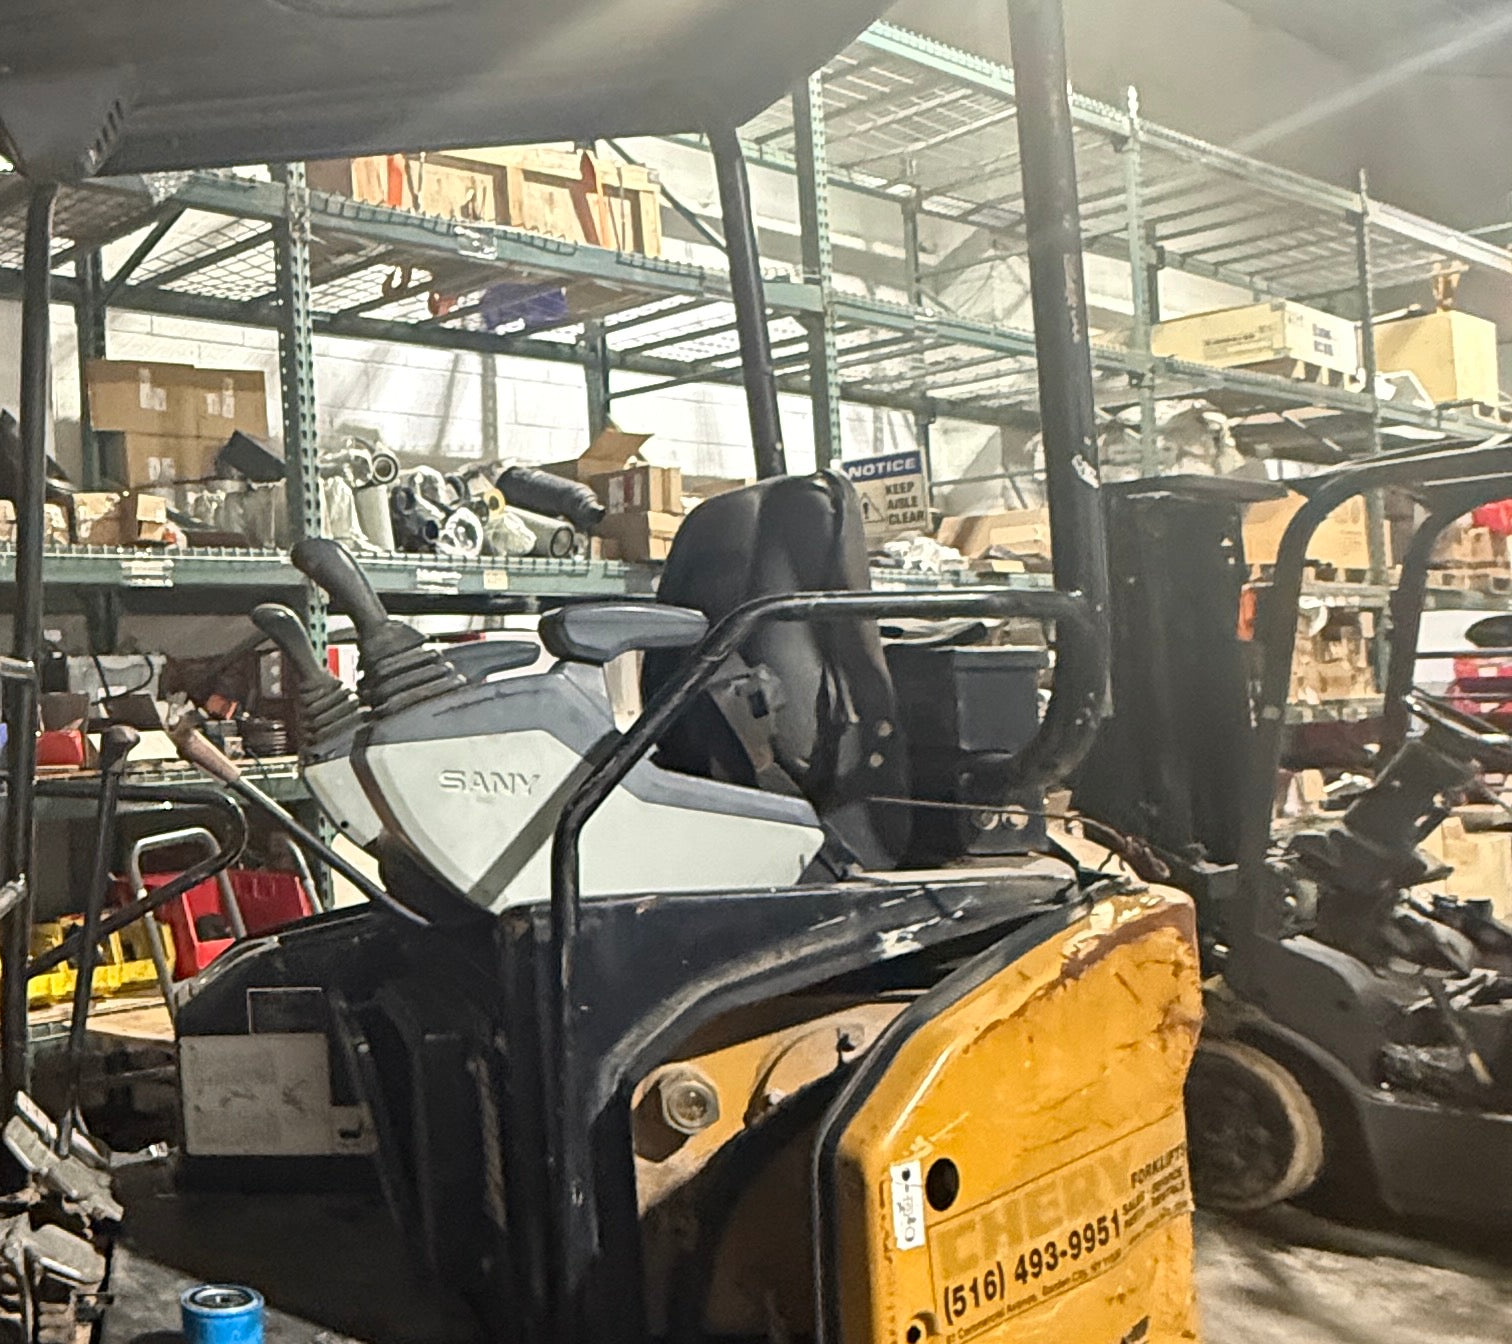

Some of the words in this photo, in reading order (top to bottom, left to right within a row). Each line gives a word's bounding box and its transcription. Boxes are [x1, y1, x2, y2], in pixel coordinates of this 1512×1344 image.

[847, 457, 916, 478] NOTICE
[886, 481, 914, 495] KEEP
[888, 496, 918, 510] AISLE
[889, 510, 925, 525] CLEAR
[438, 768, 541, 795] SANY
[944, 1260, 1005, 1326] (516)
[1014, 1208, 1120, 1285] 493-9951
